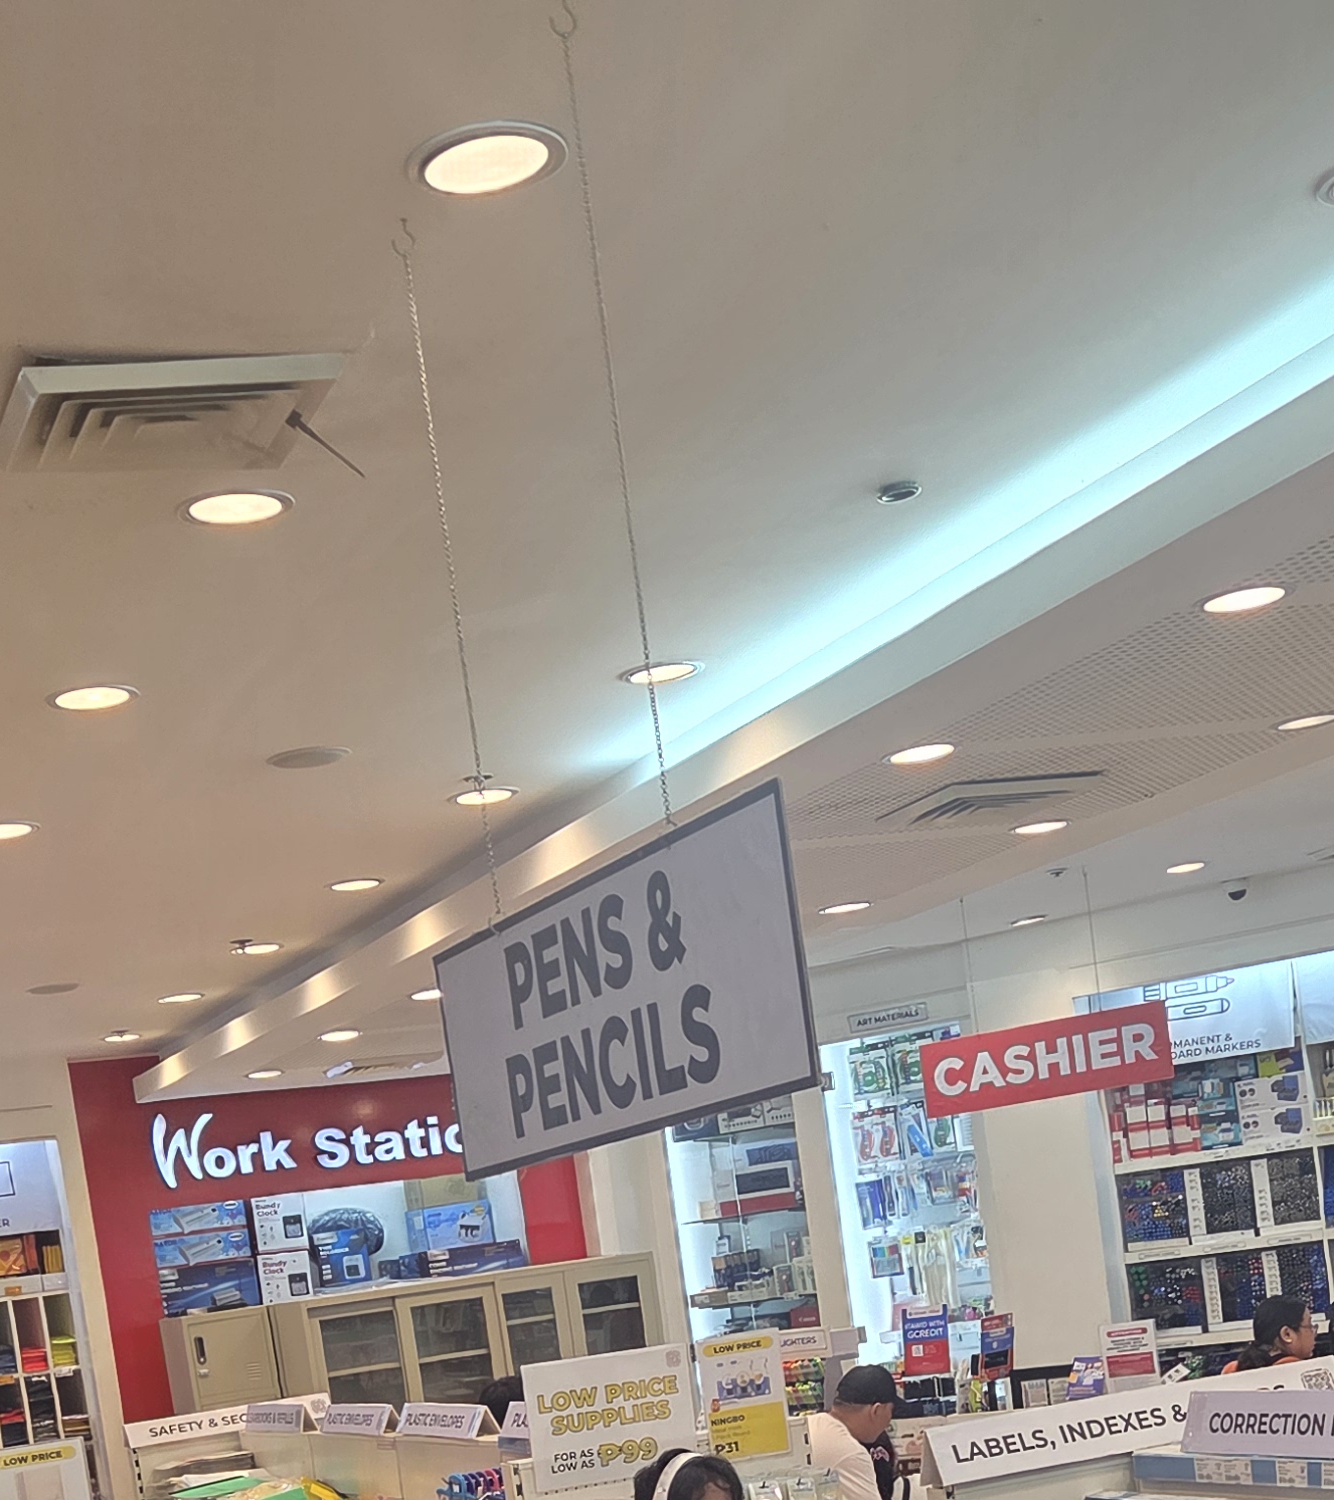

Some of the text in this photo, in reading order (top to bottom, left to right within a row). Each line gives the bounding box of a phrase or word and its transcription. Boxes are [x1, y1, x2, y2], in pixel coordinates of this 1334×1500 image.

[503, 870, 687, 1030] PENS &
[882, 1008, 920, 1023] MATERIALS
[1170, 1036, 1221, 1051] MANENT
[1204, 1039, 1261, 1056] MARKERS
[506, 984, 721, 1139] PENCILS
[933, 1023, 1158, 1095] CASHIER
[151, 1112, 464, 1190] Work Statio
[713, 1340, 762, 1354] LOW PRICE
[537, 1375, 679, 1415] LOW PRICE
[149, 1417, 219, 1437] SAFETY &
[405, 1413, 465, 1429] PLASTIC ENVELOPES
[551, 1400, 672, 1437] SUPPLIES
[1209, 1413, 1325, 1438] CORRECTION
[952, 1404, 1188, 1464] LABELS, INDEXES &
[3, 1449, 63, 1466] LOW PRICE
[551, 1458, 595, 1474] LOW AS
[554, 1449, 594, 1463] FOR AS
